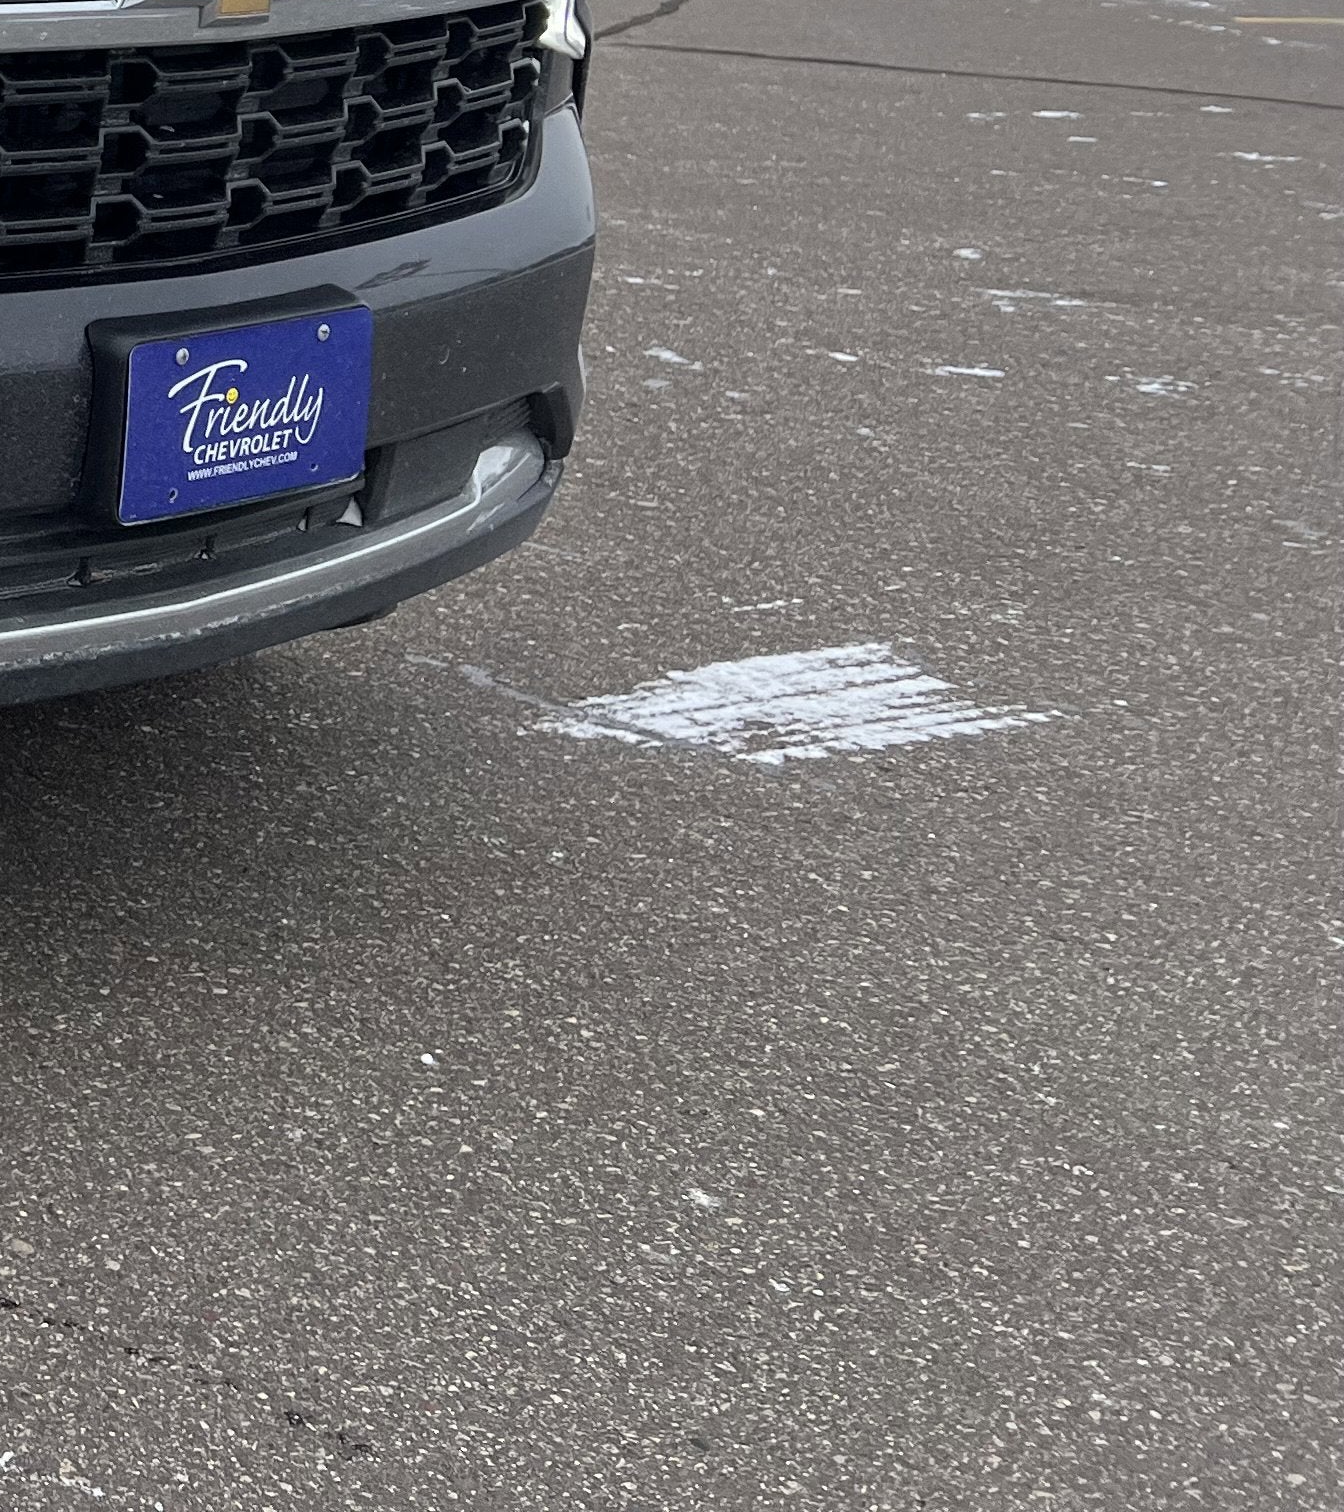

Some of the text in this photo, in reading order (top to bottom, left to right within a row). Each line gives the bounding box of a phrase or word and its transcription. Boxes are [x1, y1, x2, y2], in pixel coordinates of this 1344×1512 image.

[167, 358, 324, 453] Friendly
[193, 429, 293, 465] CHEVROLET
[187, 451, 298, 481] WWW.FRIENDLYCHEV.COM
